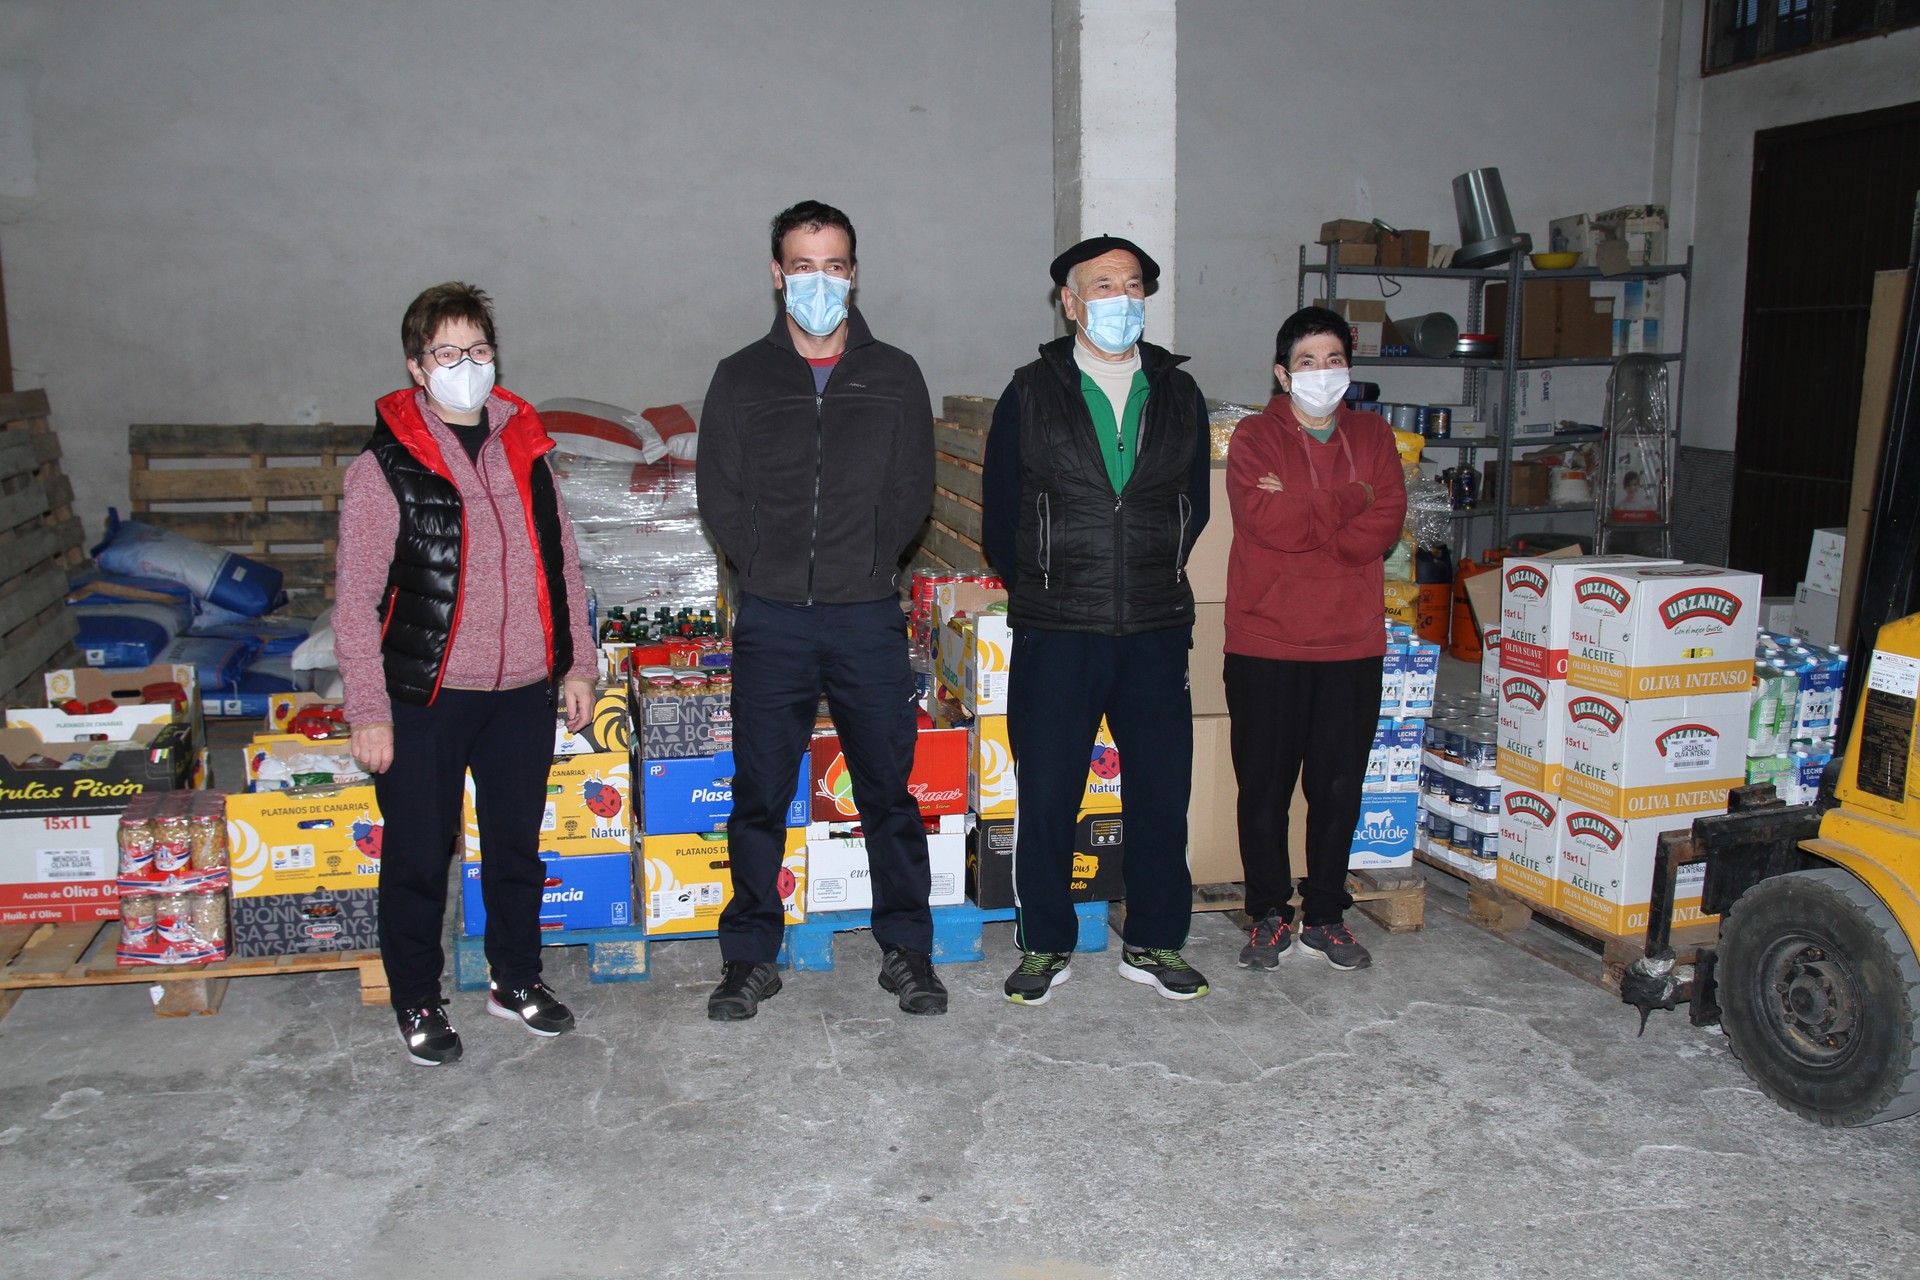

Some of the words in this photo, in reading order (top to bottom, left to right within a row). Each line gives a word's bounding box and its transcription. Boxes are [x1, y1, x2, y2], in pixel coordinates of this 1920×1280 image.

[1510, 570, 1544, 589] URZANTE
[1580, 582, 1624, 605] URZANTE
[1504, 609, 1516, 618] 15x1
[1667, 594, 1734, 618] URZANTE
[1511, 629, 1537, 645] ACEITE
[1572, 631, 1588, 642] 15x1
[1674, 626, 1685, 636] Con
[1691, 628, 1705, 638] mejor
[1706, 624, 1723, 634] Gusto
[1505, 642, 1523, 655] OLIVA
[1523, 646, 1543, 660] SUAVE
[1582, 647, 1615, 664] ACEITE
[1572, 660, 1592, 672] OLIVA
[1592, 664, 1623, 678] INTENSO
[1639, 675, 1680, 692] OLIVA
[1686, 670, 1748, 688] INTENSO
[1506, 682, 1541, 703] URZANTE
[1573, 702, 1617, 724] URZANTE
[1500, 717, 1512, 728] 15x1
[1506, 740, 1532, 758] ACEITE
[1565, 736, 1580, 748] 15x1
[1682, 744, 1704, 752] URZANTE
[1690, 750, 1710, 758] INTENSO
[1500, 752, 1516, 764] OLIVA
[1516, 756, 1539, 774] INTENSO
[1574, 761, 1607, 781] ACEITE
[552, 769, 586, 777] CANARIAS
[72, 778, 144, 798] Pisón
[1088, 783, 1122, 794] Natur
[1566, 774, 1583, 786] OLIVA
[1585, 778, 1614, 797] INTENSO
[692, 788, 733, 803] Plase
[1628, 796, 1670, 812] OLIVA
[1675, 788, 1730, 807] INTENS
[261, 806, 308, 816] PLATANOS
[324, 802, 370, 812] CANARIAS
[1510, 797, 1549, 820] URZANTE
[43, 816, 78, 830] 15x1
[82, 816, 91, 829] L
[1572, 818, 1616, 842] URZANTE
[591, 828, 628, 838] Natur
[1500, 828, 1516, 840] 15x1
[676, 848, 718, 856] PLATANOS
[1563, 851, 1578, 864] 15x1
[72, 860, 92, 868] SUAVE
[1510, 852, 1540, 872] ACEITE
[1502, 863, 1519, 877] OLIVA
[1520, 870, 1547, 888] INTENSO
[22, 892, 48, 900] Aceite
[62, 886, 98, 898] Oliva
[1572, 876, 1605, 898] ACEITE
[542, 888, 584, 903] encia
[1564, 887, 1581, 901] OLIVA
[1583, 896, 1613, 914] INTENSO
[3, 912, 28, 920] Huile
[96, 908, 120, 916] Olive
